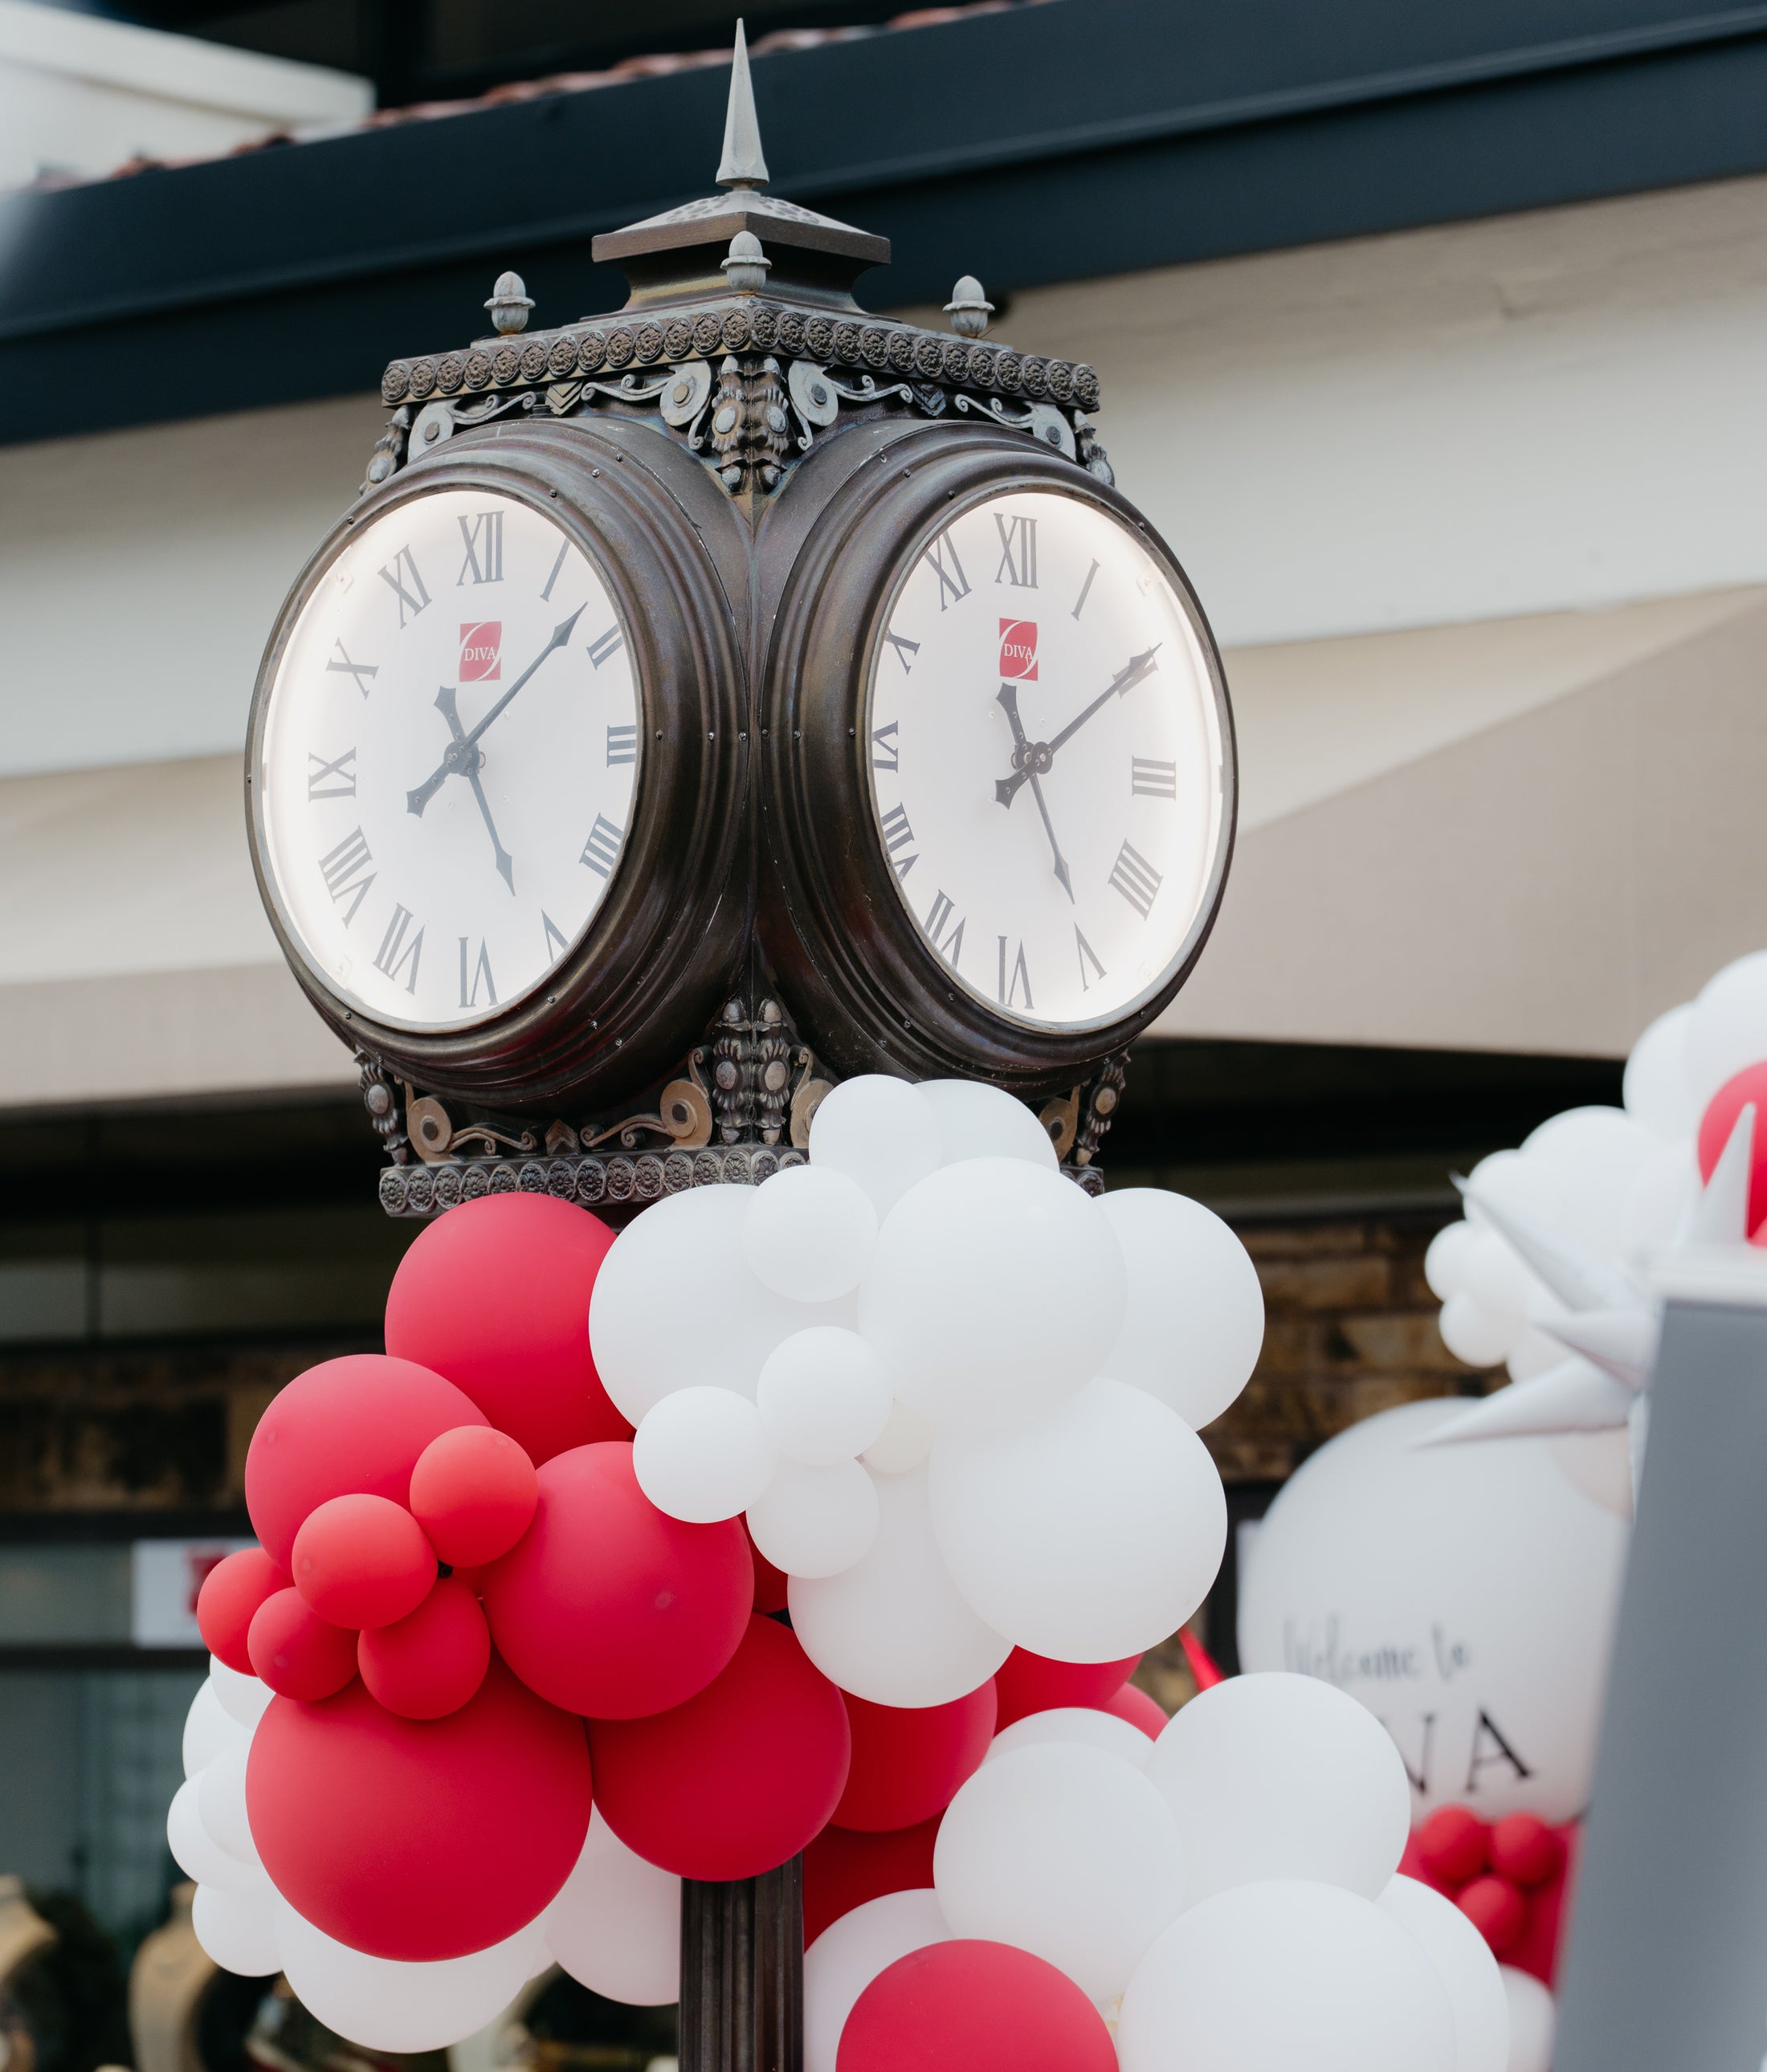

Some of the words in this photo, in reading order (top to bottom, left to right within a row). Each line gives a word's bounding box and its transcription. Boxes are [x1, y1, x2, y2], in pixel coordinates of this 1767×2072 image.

[457, 511, 504, 585] XII
[540, 536, 572, 602] I
[924, 530, 972, 612] XI
[994, 512, 1038, 588] XII
[377, 544, 432, 630] XI
[1071, 558, 1100, 621] I
[325, 638, 379, 700] X
[464, 646, 496, 662] DIVA
[586, 622, 624, 671] II
[1003, 643, 1034, 661] DIVA
[308, 746, 356, 802] IX
[607, 724, 637, 769] III
[1132, 755, 1177, 801] III
[318, 826, 378, 929] VIII
[578, 812, 624, 880] IIII
[1108, 838, 1163, 921] IIII
[373, 902, 426, 995] VII
[458, 936, 500, 1008] VI
[998, 935, 1034, 1010] VI
[1074, 921, 1108, 992] V
[1283, 1615, 1421, 1684] Welcome
[1431, 1624, 1471, 1684] to
